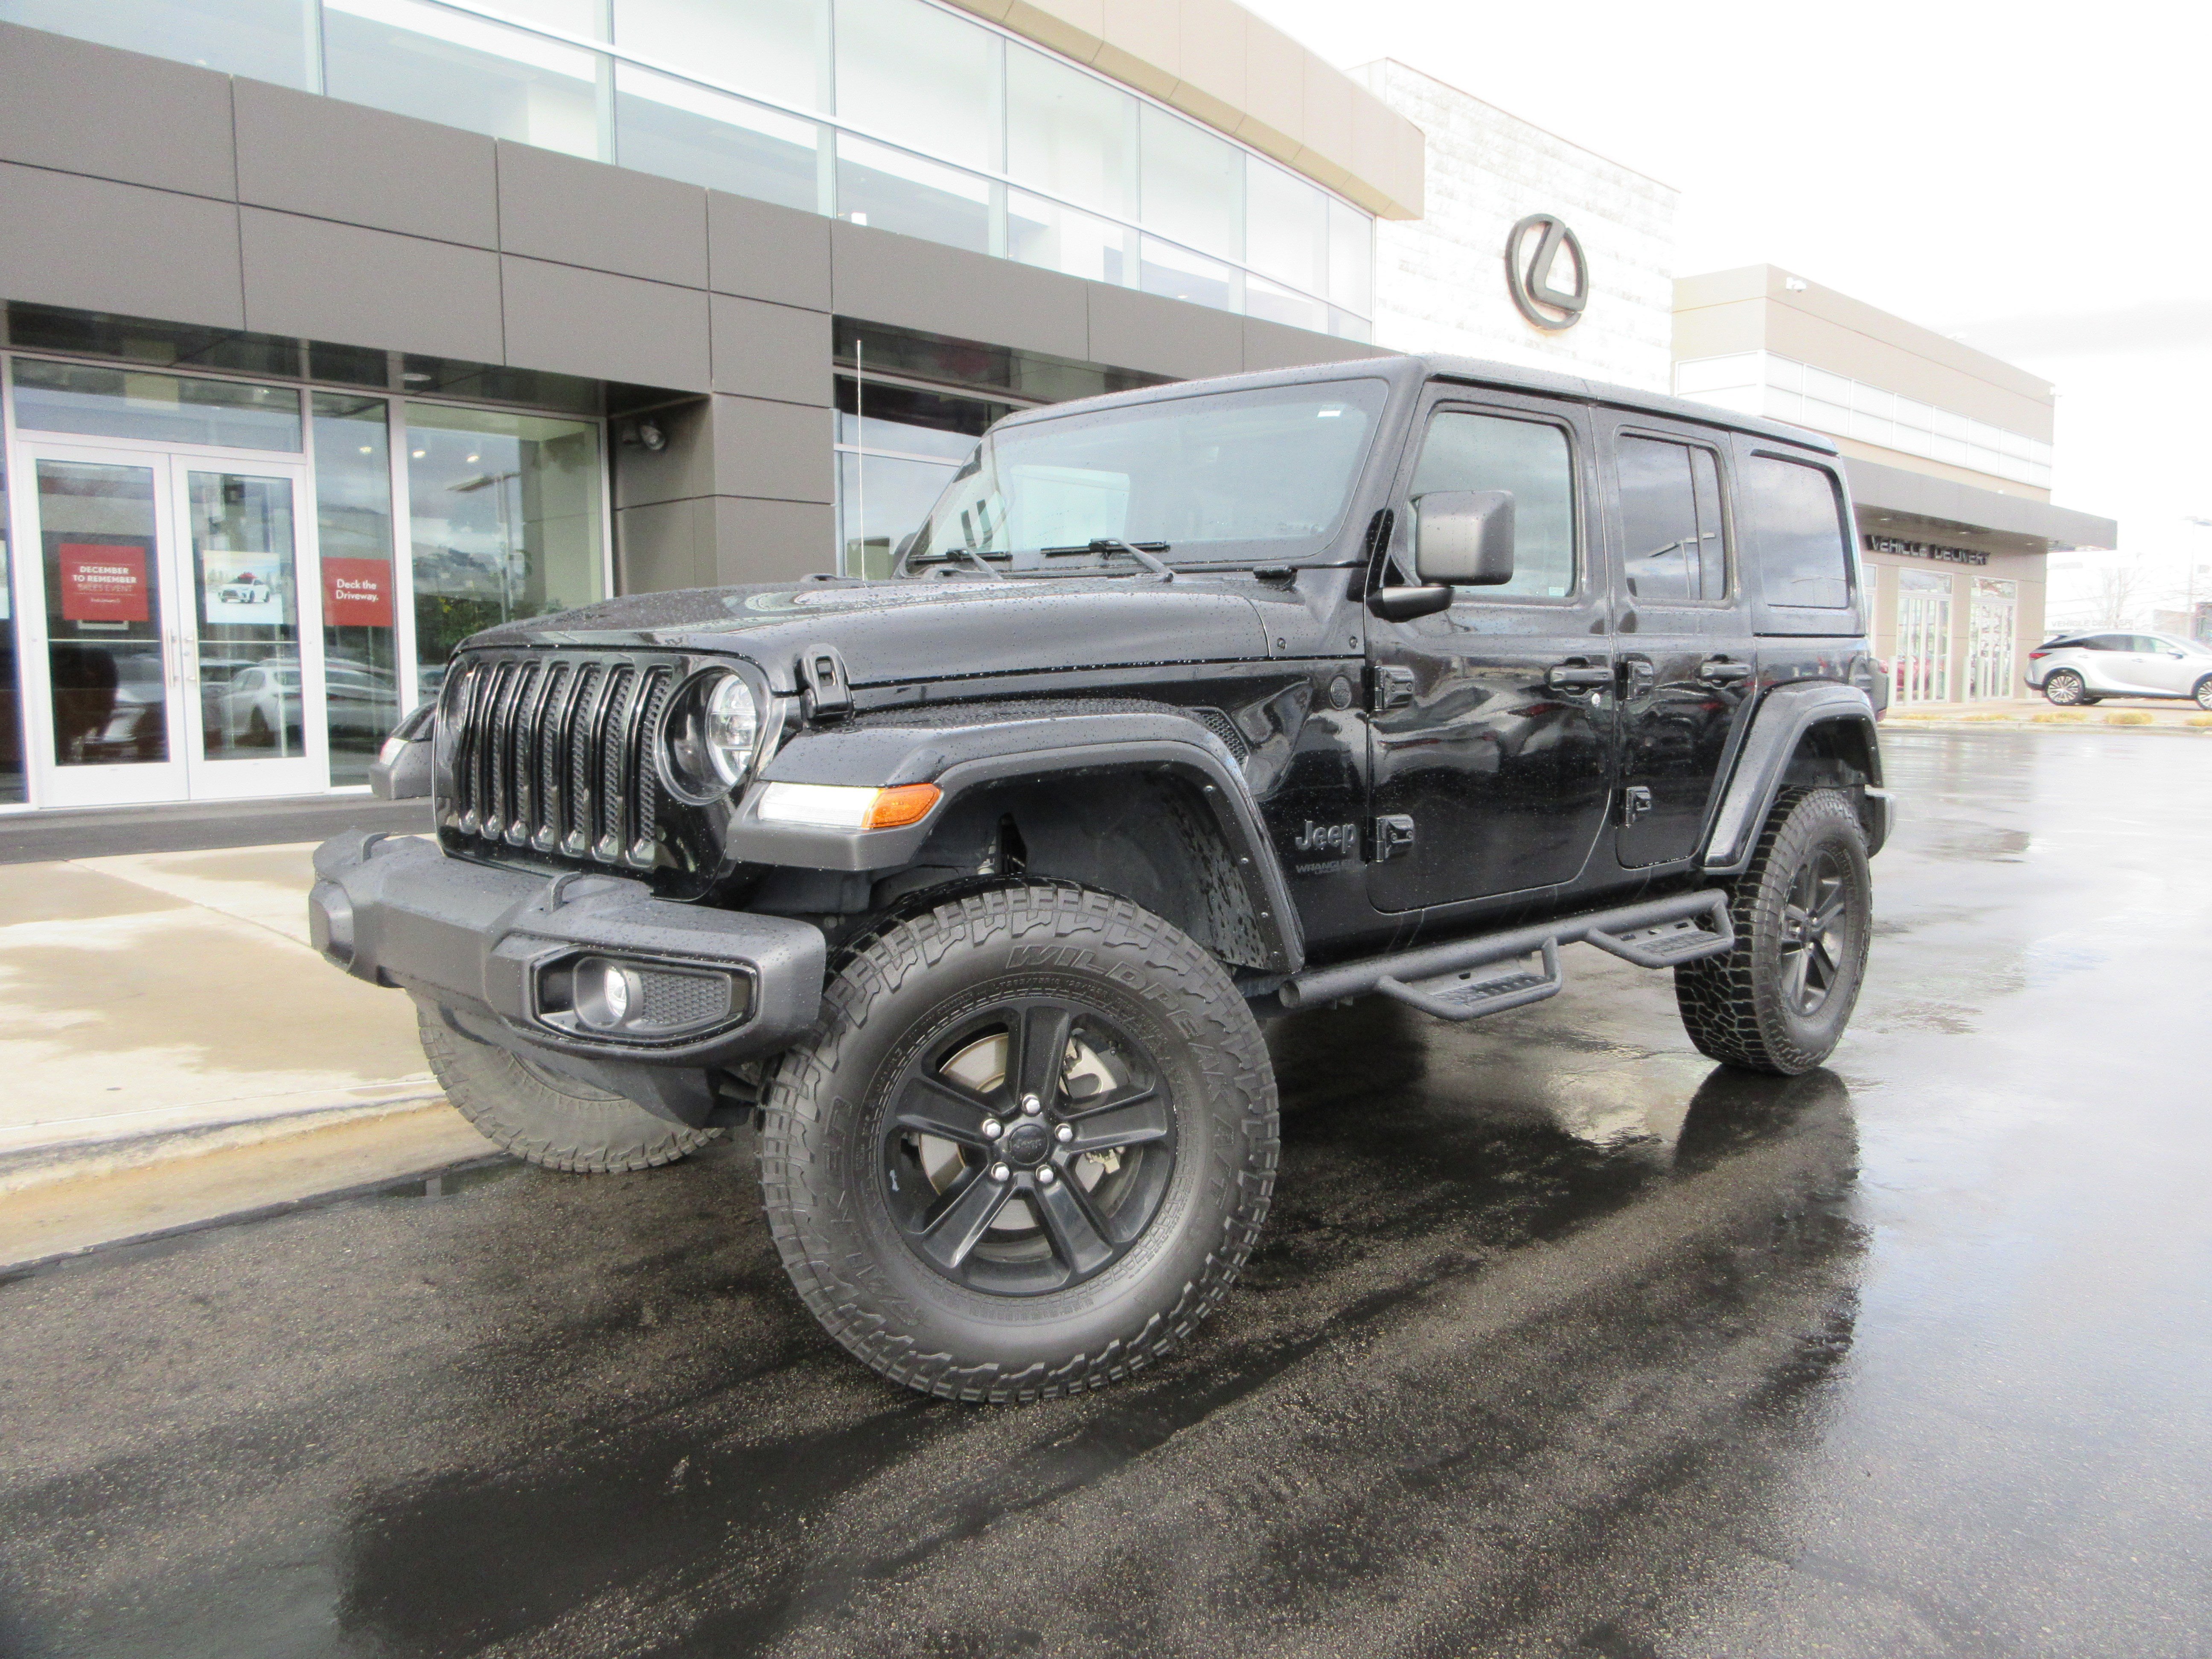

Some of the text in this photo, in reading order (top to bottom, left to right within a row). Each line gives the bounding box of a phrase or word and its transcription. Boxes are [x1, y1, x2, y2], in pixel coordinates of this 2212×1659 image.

[1867, 534, 1928, 557] VEHICLE
[79, 566, 129, 574] DECEMBER
[87, 575, 137, 583] REMEMBER
[337, 579, 377, 590] Deck the
[336, 589, 378, 602] Driveway.
[1295, 820, 1357, 854] Jeep
[1295, 859, 1355, 873] WRANGLER
[1006, 944, 1234, 1109] WILDPEAK
